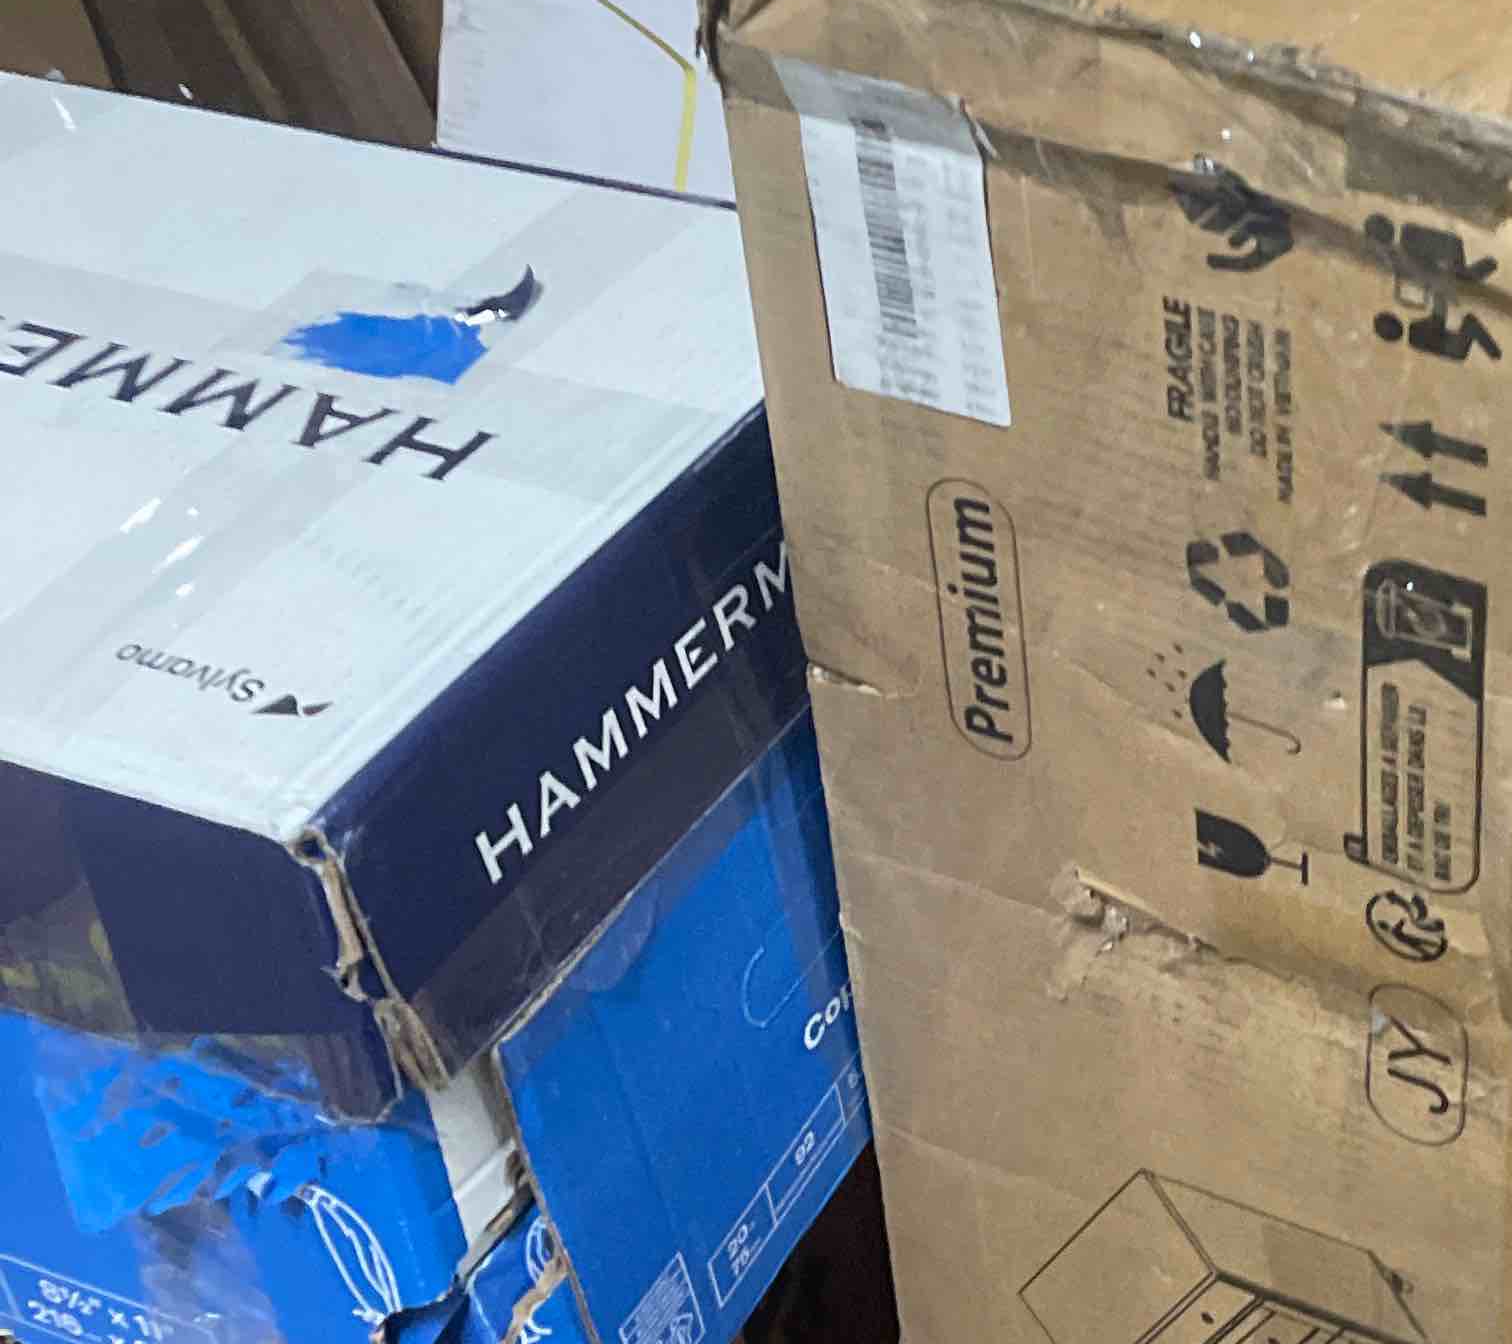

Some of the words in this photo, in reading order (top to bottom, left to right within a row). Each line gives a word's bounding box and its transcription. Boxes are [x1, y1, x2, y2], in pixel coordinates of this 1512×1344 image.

[0, 314, 498, 482] HAMME
[1163, 295, 1195, 423] FRAGILE
[115, 642, 264, 703] Sylvamo
[947, 496, 1013, 744] Premium
[1387, 1014, 1453, 1115] JY
